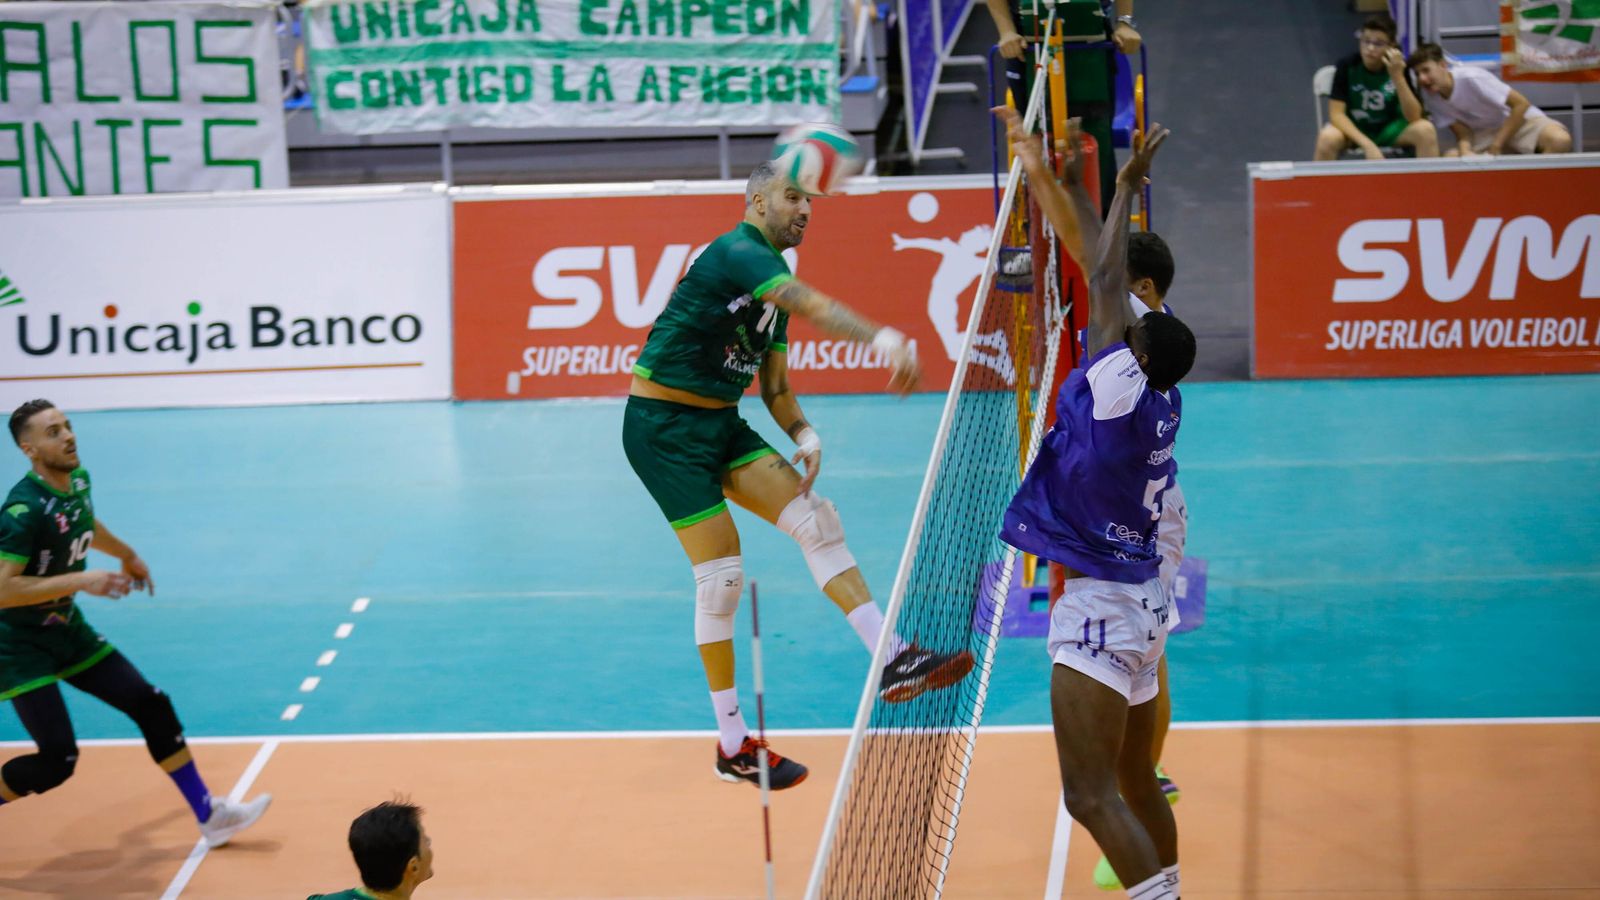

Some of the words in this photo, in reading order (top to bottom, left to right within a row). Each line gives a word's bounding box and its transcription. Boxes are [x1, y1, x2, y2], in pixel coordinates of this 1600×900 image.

[552, 64, 614, 103] LA
[1360, 90, 1385, 111] 13
[1332, 214, 1600, 303] SVM
[17, 302, 236, 364] Unicaja
[249, 305, 422, 348] Banco
[1325, 318, 1463, 350] SUPERLIGA
[1469, 316, 1590, 348] VOLEIBOL
[520, 344, 640, 377] SUPERLIG
[67, 530, 94, 566] 10
